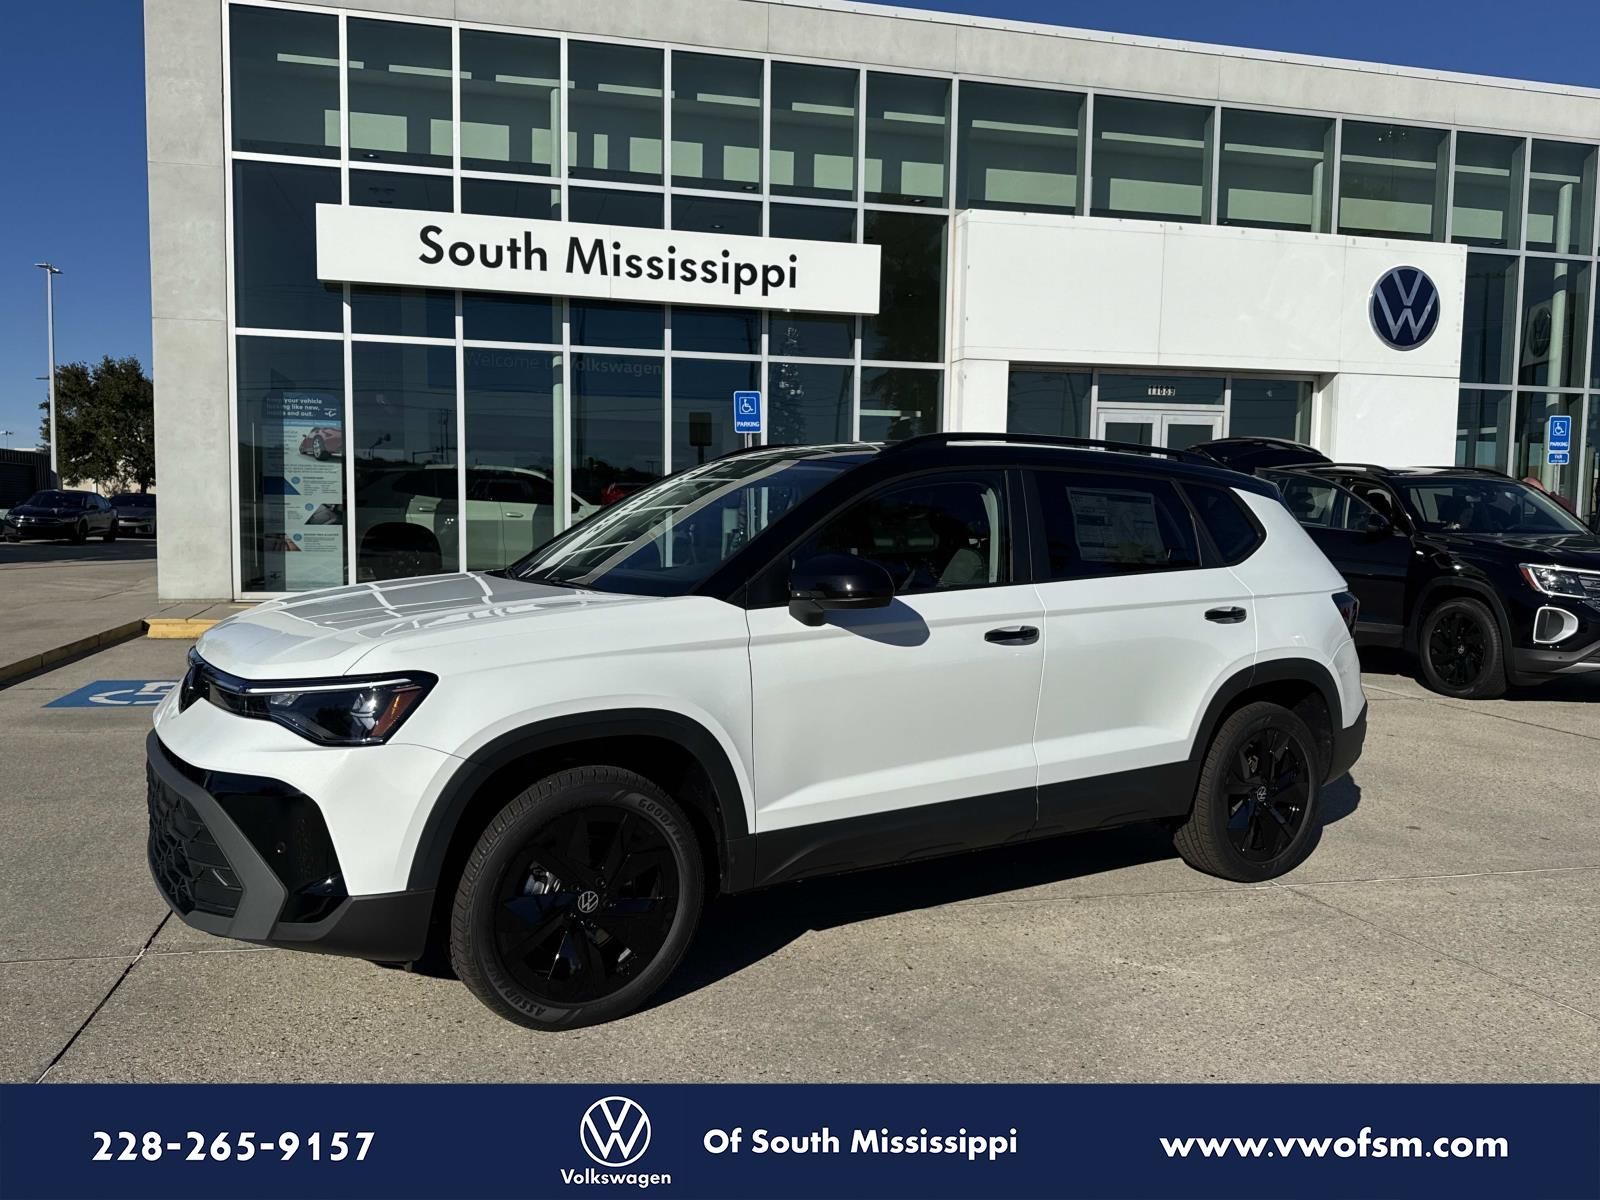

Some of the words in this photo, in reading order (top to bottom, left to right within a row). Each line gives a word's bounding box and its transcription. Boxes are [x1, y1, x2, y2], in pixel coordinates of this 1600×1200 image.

[420, 226, 547, 271] South
[566, 236, 797, 296] Mississippi
[464, 351, 540, 369] Welcome
